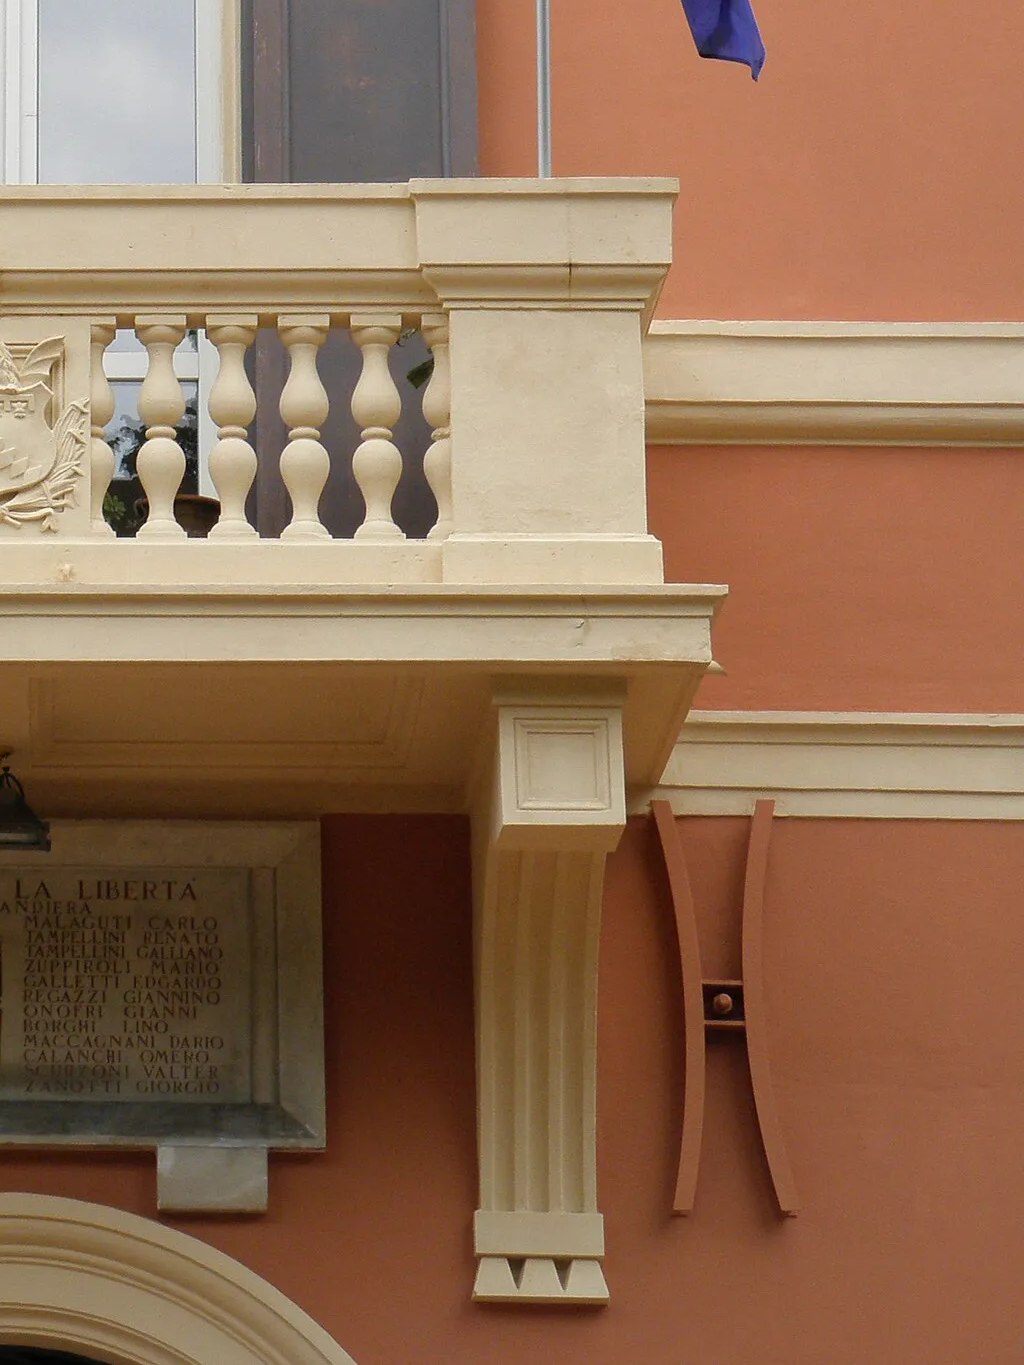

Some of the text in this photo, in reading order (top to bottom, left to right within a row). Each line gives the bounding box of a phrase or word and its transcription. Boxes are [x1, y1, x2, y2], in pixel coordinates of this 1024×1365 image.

[15, 879, 53, 900] LA
[23, 916, 218, 931] MALAGUTI CARLO
[27, 931, 219, 945] TAMPELLINI RENATO
[27, 945, 125, 959] TAMPELLINI
[26, 960, 220, 975] ZUPPIROLI MARIO
[23, 975, 222, 989] GALLETTI EDGARDO
[23, 990, 221, 1005] REGAZZI GIANNINO
[23, 1005, 197, 1019] ONOFRI GIANNI
[23, 1020, 169, 1034] BORGHI LINO
[23, 1035, 224, 1050] MACCAGNANI DARIO
[23, 1049, 209, 1064] CALANCHI OMERO
[143, 1066, 218, 1079] VALTER
[26, 1080, 220, 1094] ZANOTTI GIORGIO
